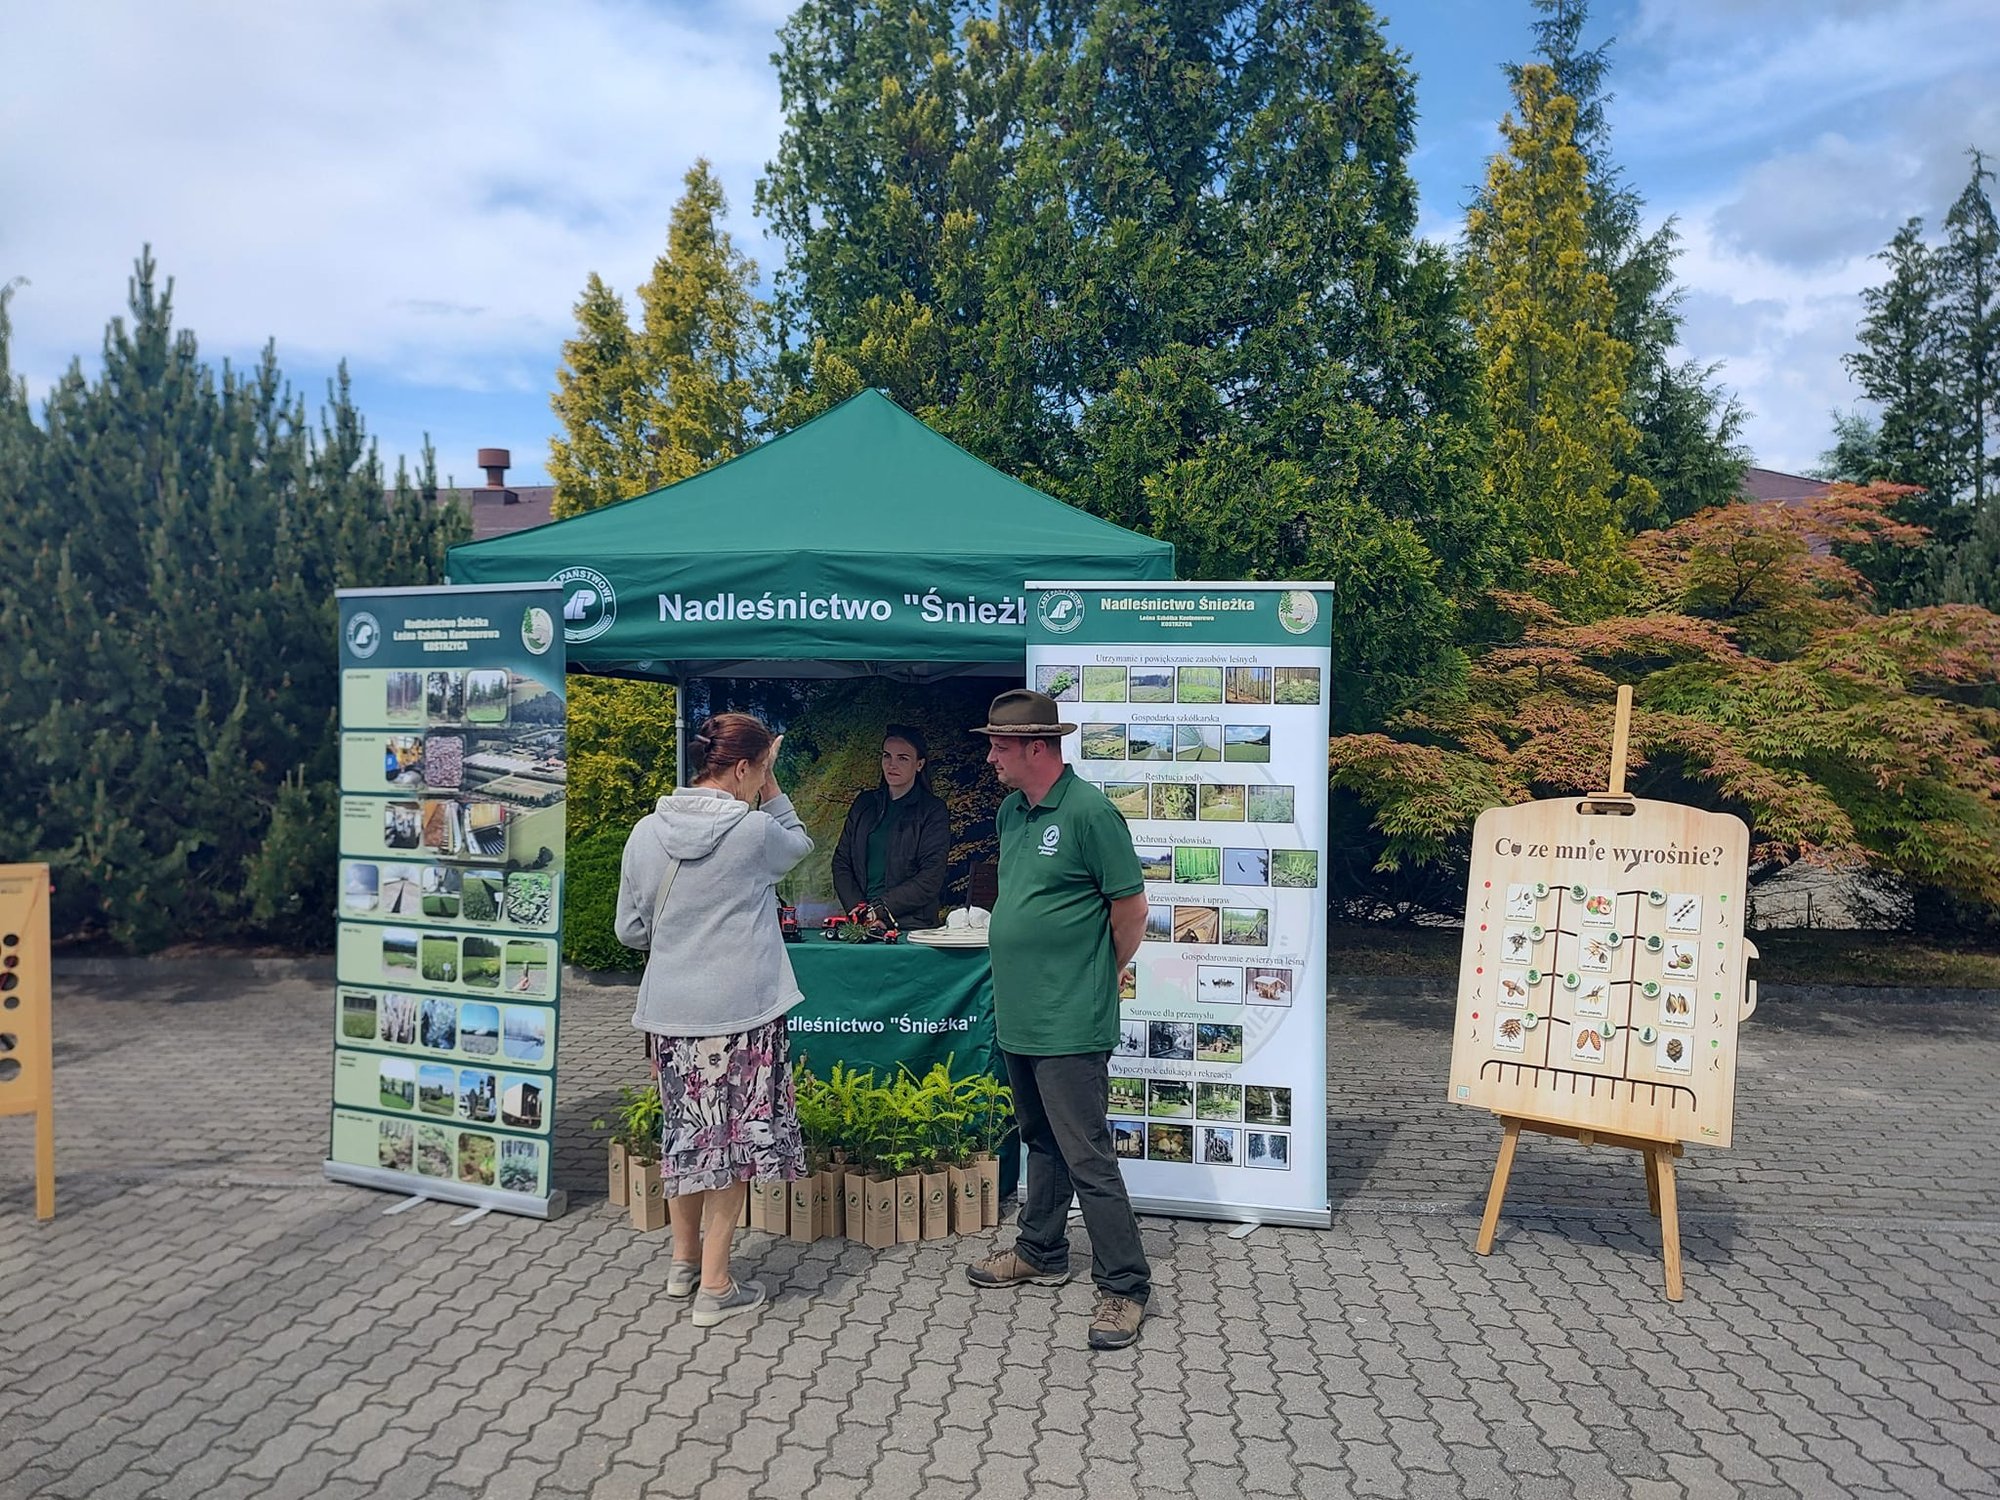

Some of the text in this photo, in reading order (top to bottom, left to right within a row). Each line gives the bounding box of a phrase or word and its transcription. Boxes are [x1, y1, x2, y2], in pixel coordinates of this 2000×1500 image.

[559, 569, 613, 603] PAŃSTWOWE
[658, 592, 892, 621] Nadleśnictwo
[1100, 596, 1255, 611] Nadleśnictwo Śnieżka
[1096, 654, 1138, 664] Utrzymanie
[1144, 655, 1193, 664] powiększanie
[1195, 655, 1228, 663] zasobów
[1229, 656, 1258, 664] leśnych
[1131, 714, 1220, 723] Gospodarka szkółkarska
[1145, 772, 1204, 783] Restytucja jodły
[1136, 834, 1212, 845] Ochrona Środowiska
[1527, 843, 1549, 858] ze
[1555, 838, 1606, 861] mnie
[1612, 842, 1724, 873] wyrośnie?
[1149, 894, 1200, 903] drzewostanów
[1207, 897, 1230, 905] upraw
[1181, 952, 1305, 967] Gospodarowanie zwierzyną leśną
[1130, 1007, 1215, 1021] Surowce dla przemysłu
[787, 1013, 977, 1034] dleśnictwo "Śnieżka"
[1111, 1063, 1158, 1076] Wypoczynek
[1159, 1067, 1192, 1078] edukacja
[1198, 1071, 1232, 1080] rekreacja
